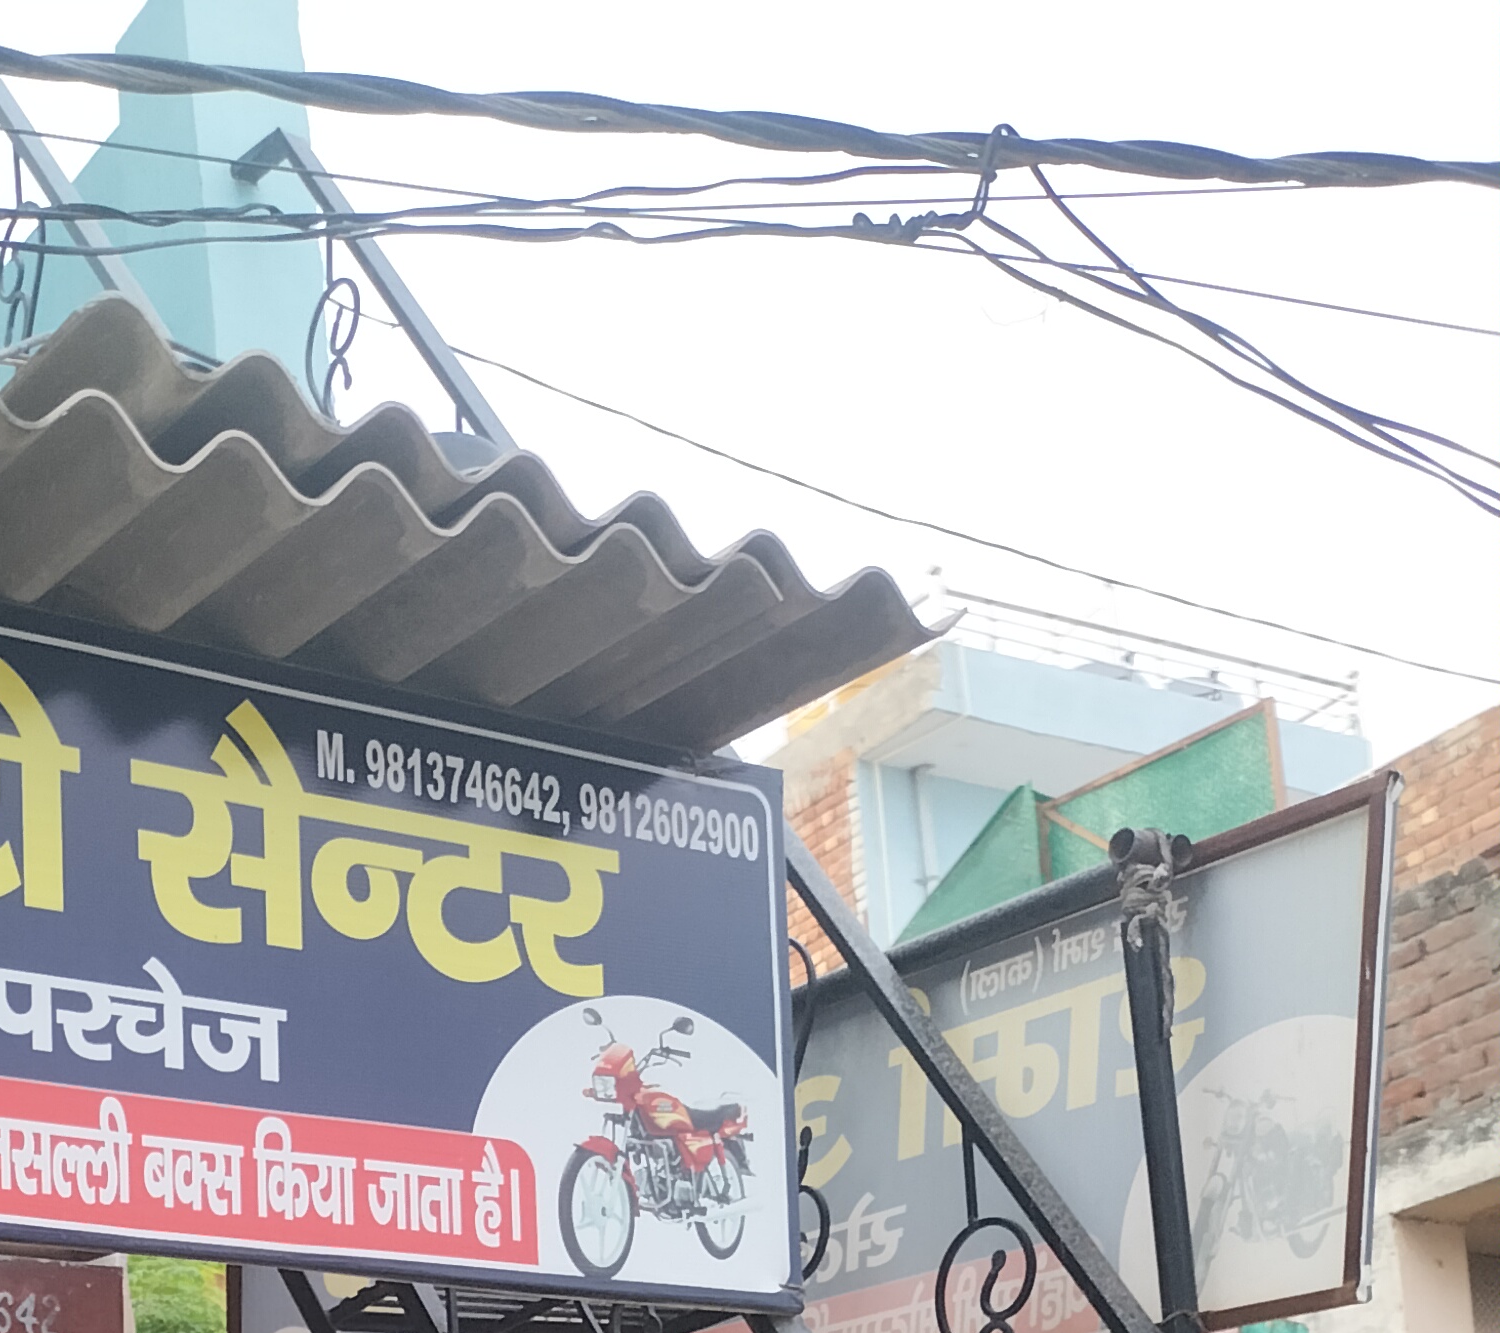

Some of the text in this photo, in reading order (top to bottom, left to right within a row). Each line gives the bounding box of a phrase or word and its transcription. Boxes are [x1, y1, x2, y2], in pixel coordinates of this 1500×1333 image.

[130, 699, 620, 998] सैन्टर
[316, 730, 759, 861] M. 9813746642, 9812602900
[141, 1135, 244, 1216] बक्स
[253, 1117, 356, 1226] किया
[364, 1157, 464, 1235] जाता
